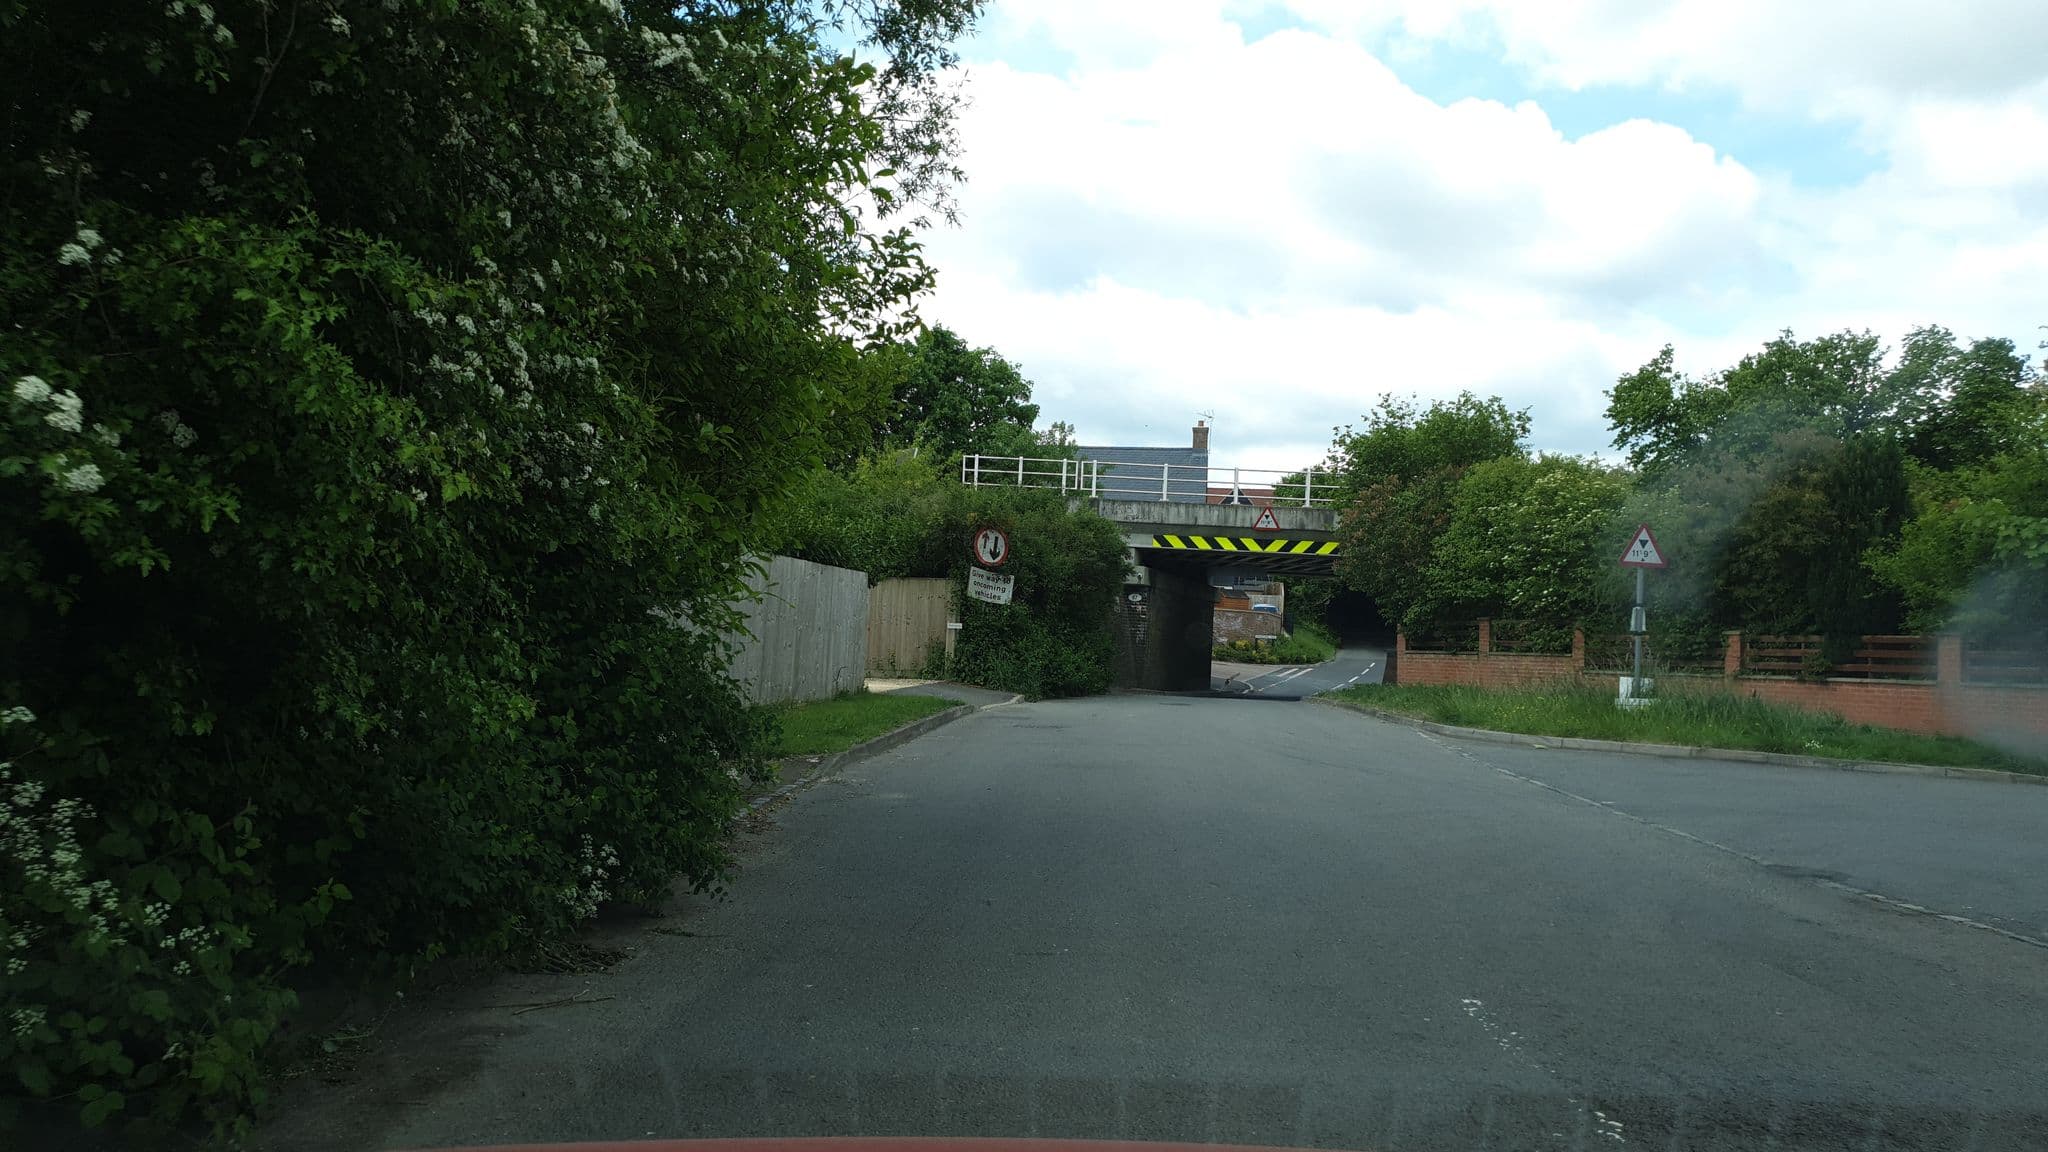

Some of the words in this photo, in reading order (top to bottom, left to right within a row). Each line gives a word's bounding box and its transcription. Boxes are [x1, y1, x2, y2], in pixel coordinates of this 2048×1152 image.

[972, 570, 984, 579] Give
[986, 574, 1000, 583] way
[973, 580, 1006, 593] oncoming
[974, 590, 1001, 600] vehicles
